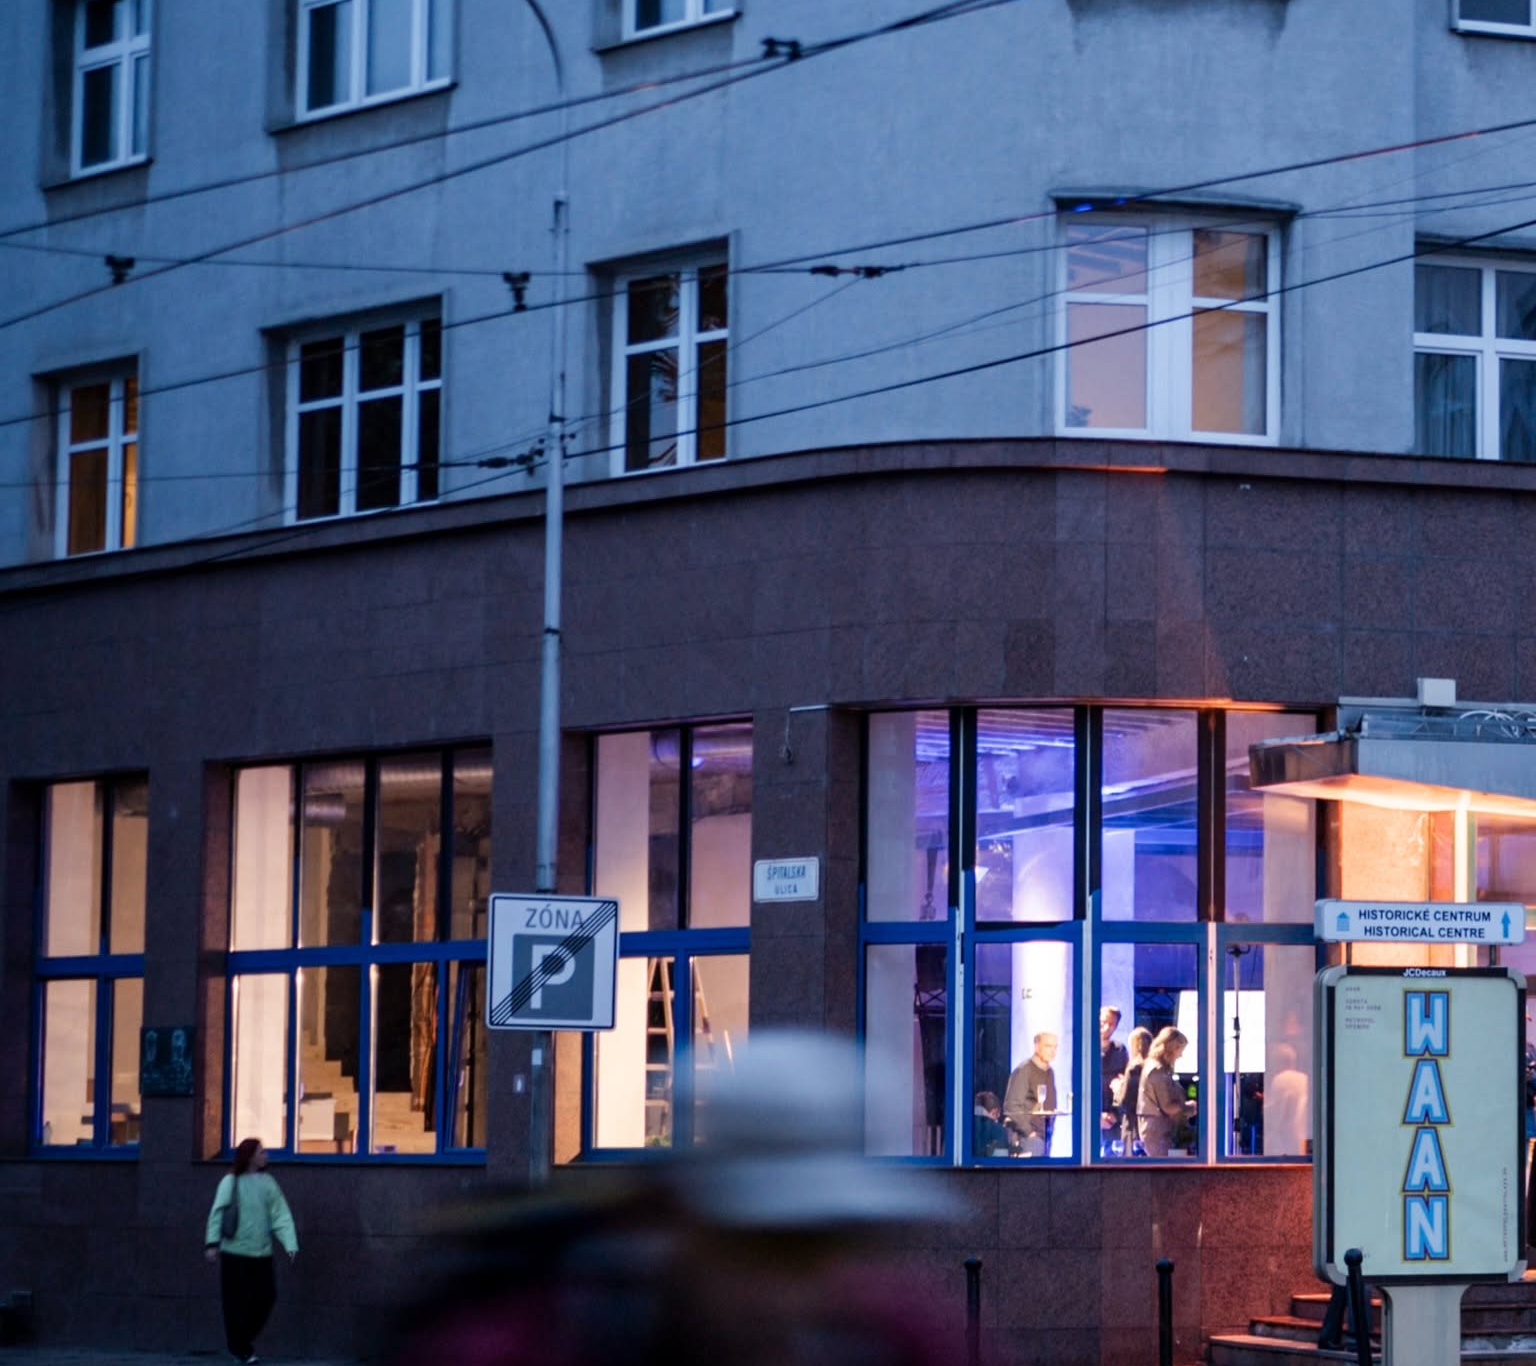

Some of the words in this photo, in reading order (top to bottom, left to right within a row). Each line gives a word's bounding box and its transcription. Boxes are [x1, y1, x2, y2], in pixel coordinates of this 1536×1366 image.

[525, 903, 584, 930] ZÓNA
[1358, 908, 1430, 921] HISTORICKÉ
[1433, 910, 1491, 922] CENTRUM
[1364, 926, 1434, 938] HISTORICAL
[1438, 927, 1485, 938] CENTRE
[530, 944, 576, 1009] P
[1403, 968, 1446, 977] JCDecaux
[1402, 988, 1452, 1261] WAAN
